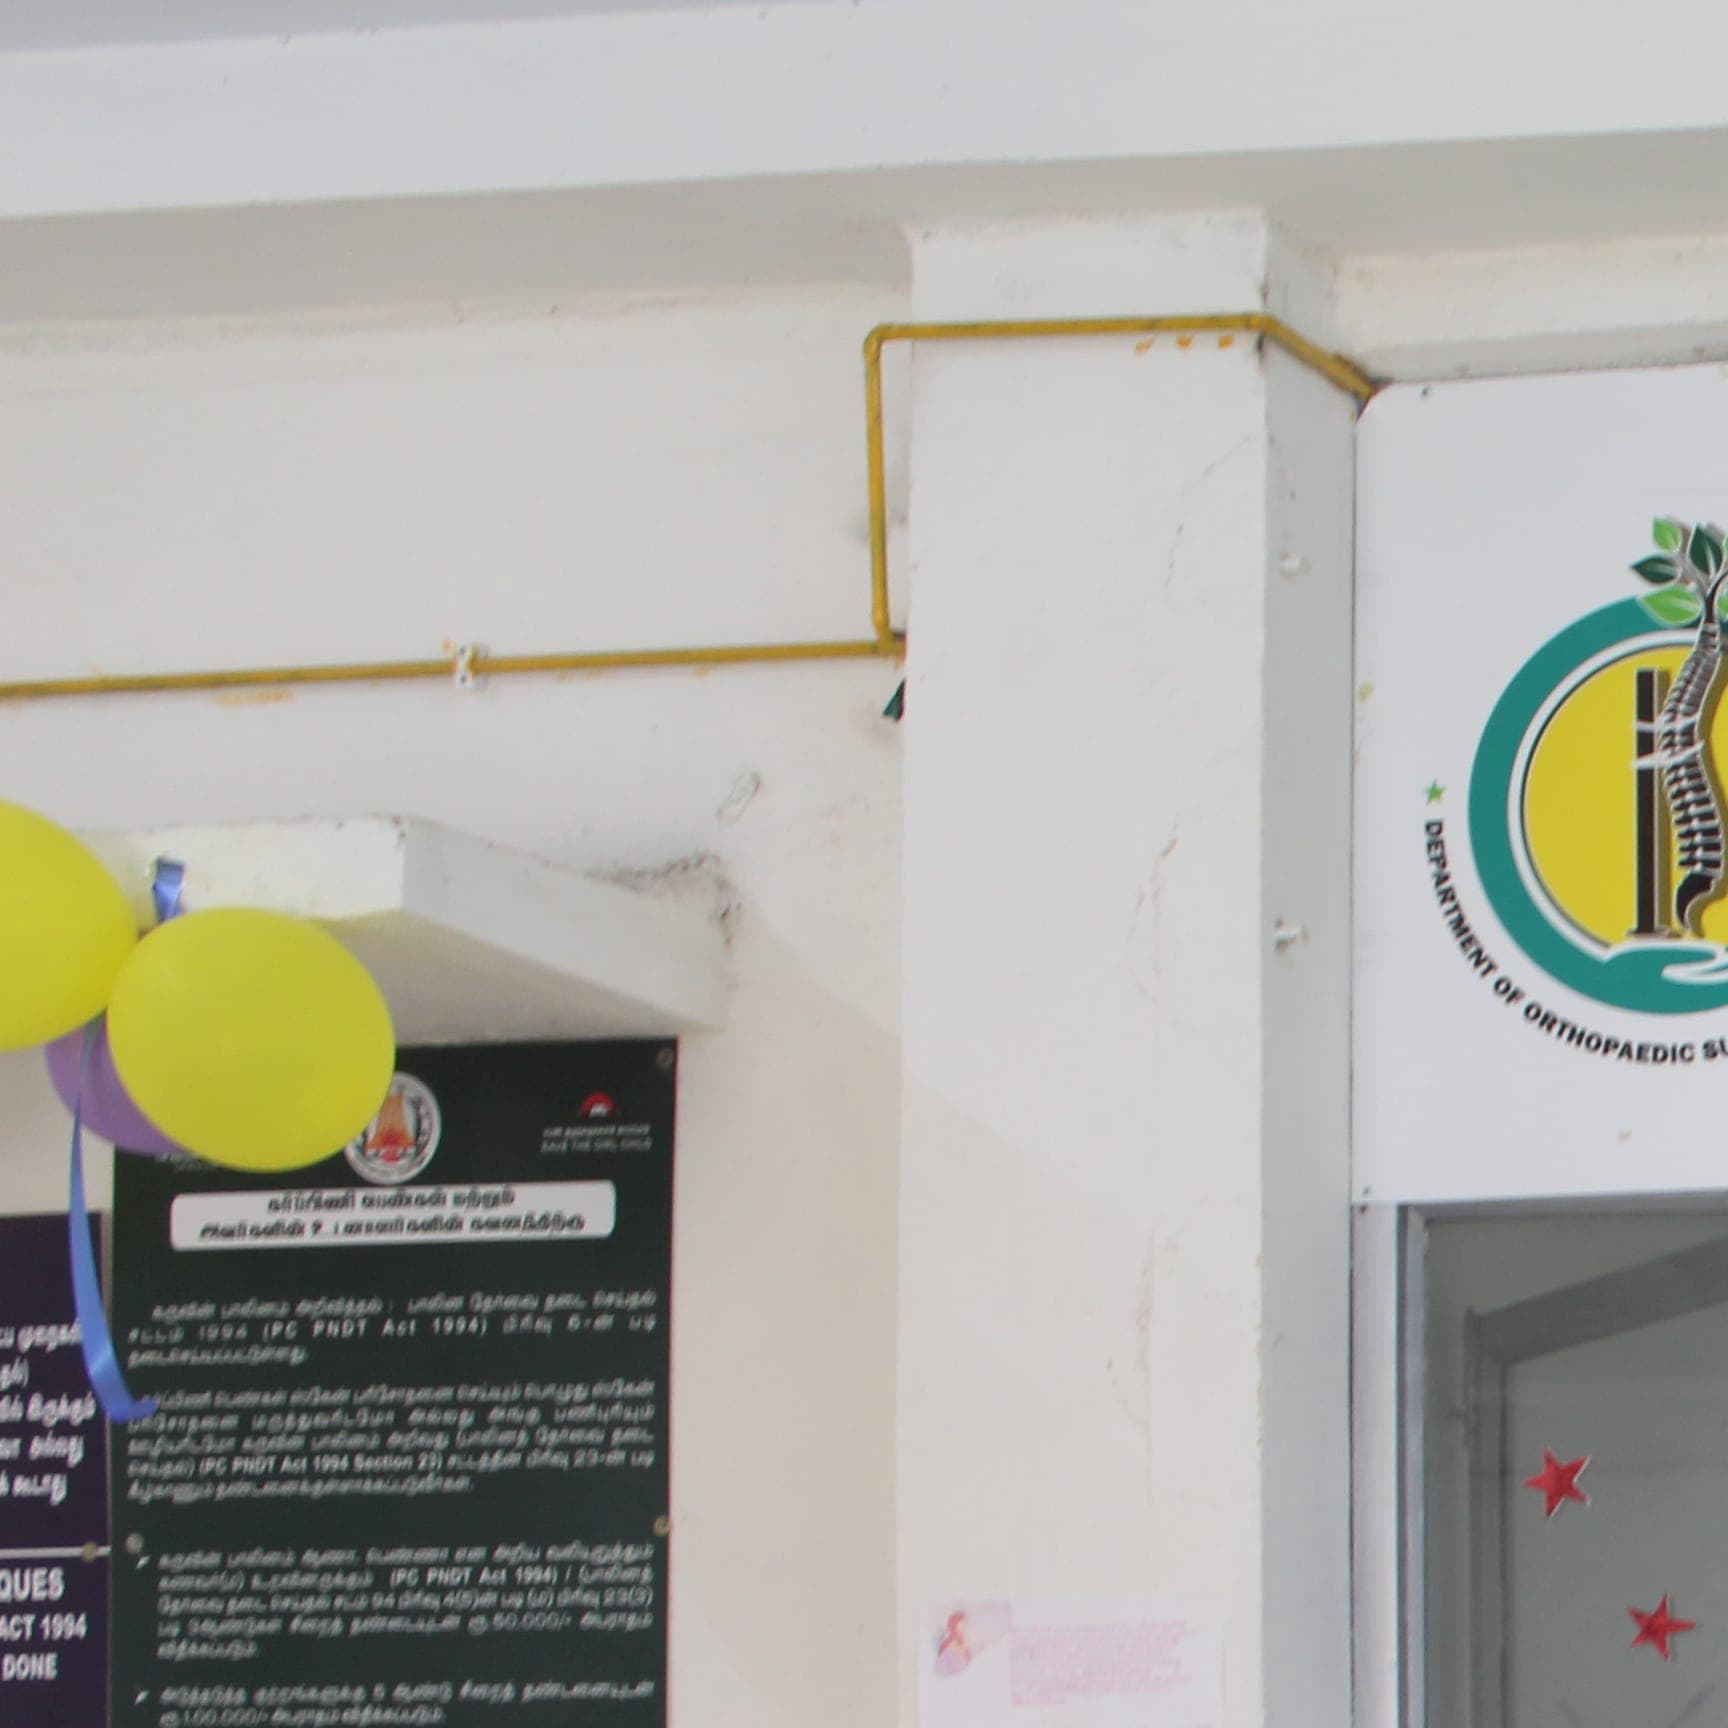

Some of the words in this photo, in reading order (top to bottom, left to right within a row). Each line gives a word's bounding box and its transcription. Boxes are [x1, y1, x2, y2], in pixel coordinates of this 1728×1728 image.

[1424, 820, 1498, 979] DEPARTMENT
[1492, 974, 1526, 1008] OF
[1523, 998, 1696, 1065] ORTHOPAEDIC
[41, 1611, 89, 1641] 1994
[2, 1652, 58, 1681] DONE
